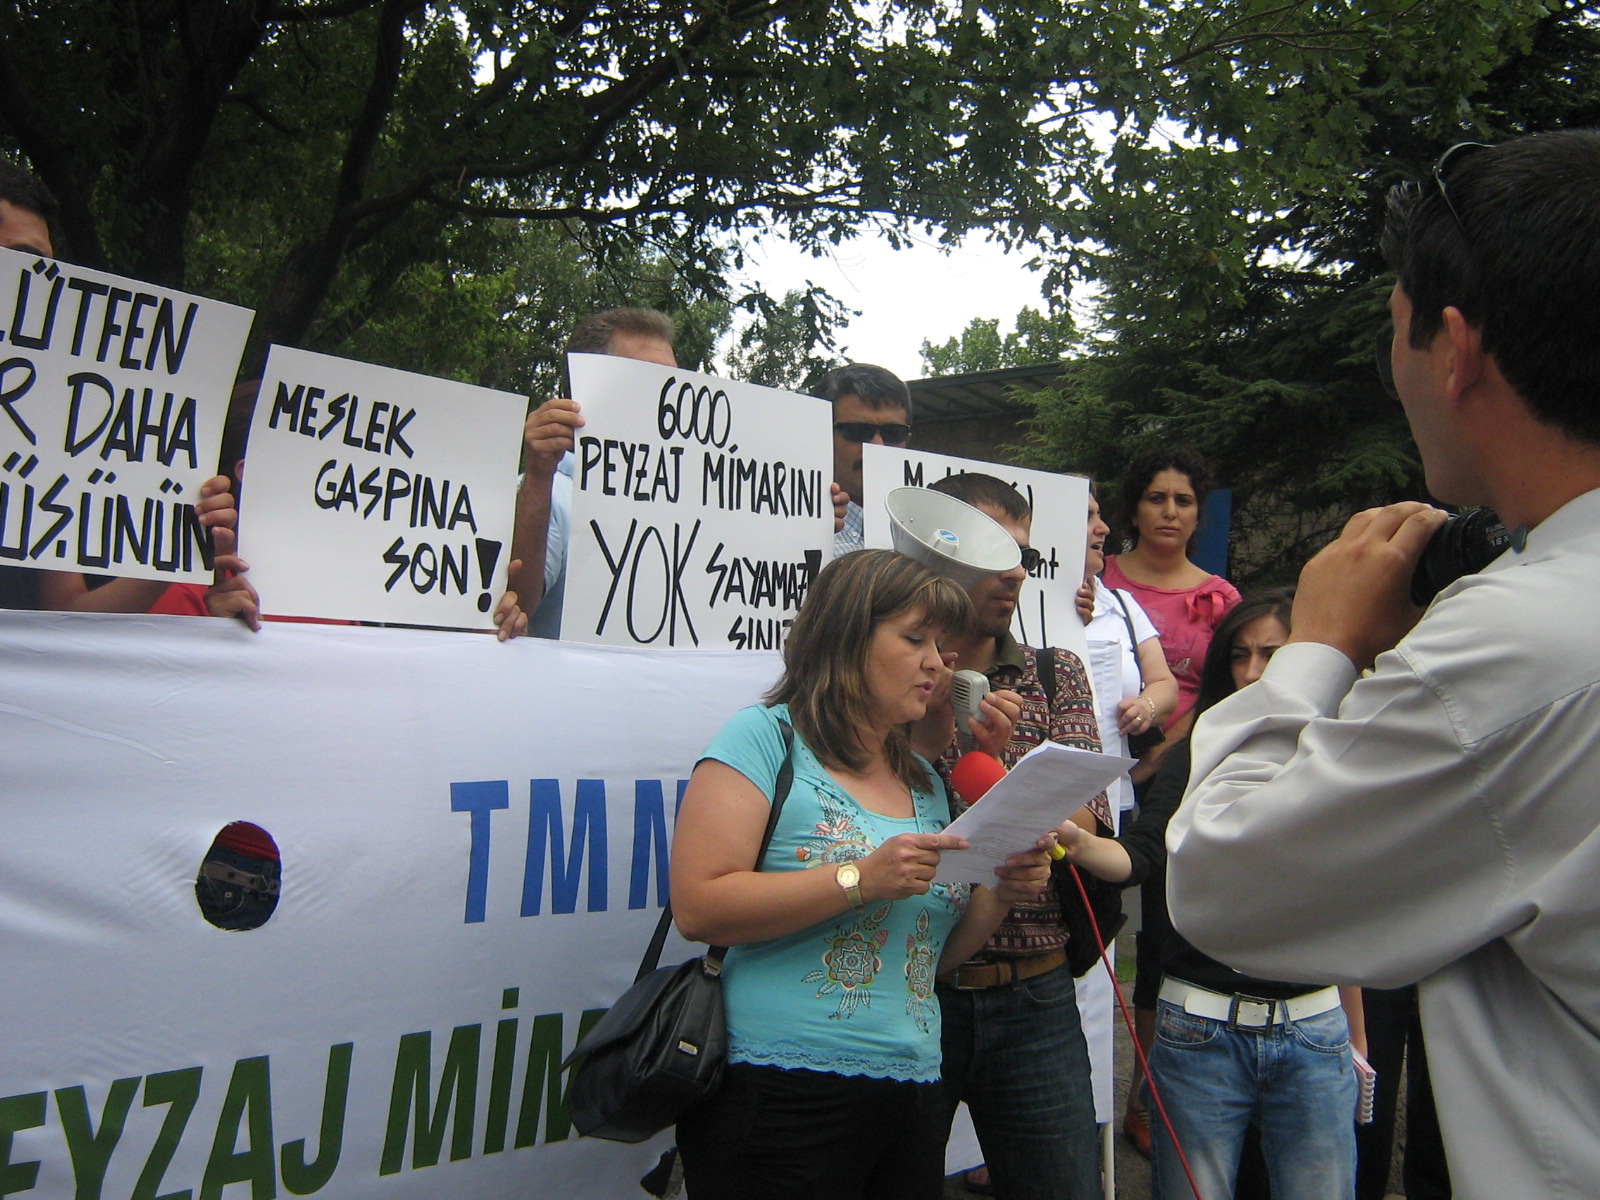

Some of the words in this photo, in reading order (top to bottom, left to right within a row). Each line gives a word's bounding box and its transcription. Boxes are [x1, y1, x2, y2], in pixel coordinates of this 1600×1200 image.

[0, 258, 199, 375] ÜTFEN
[64, 372, 198, 469] DAHA
[269, 381, 417, 459] MESLEK
[657, 376, 731, 449] 6000
[314, 459, 478, 535] GASPINA
[580, 436, 685, 503] PEYZAJ
[702, 443, 822, 519] MİMARINI
[382, 536, 503, 613] SON!
[589, 518, 701, 648] YOK
